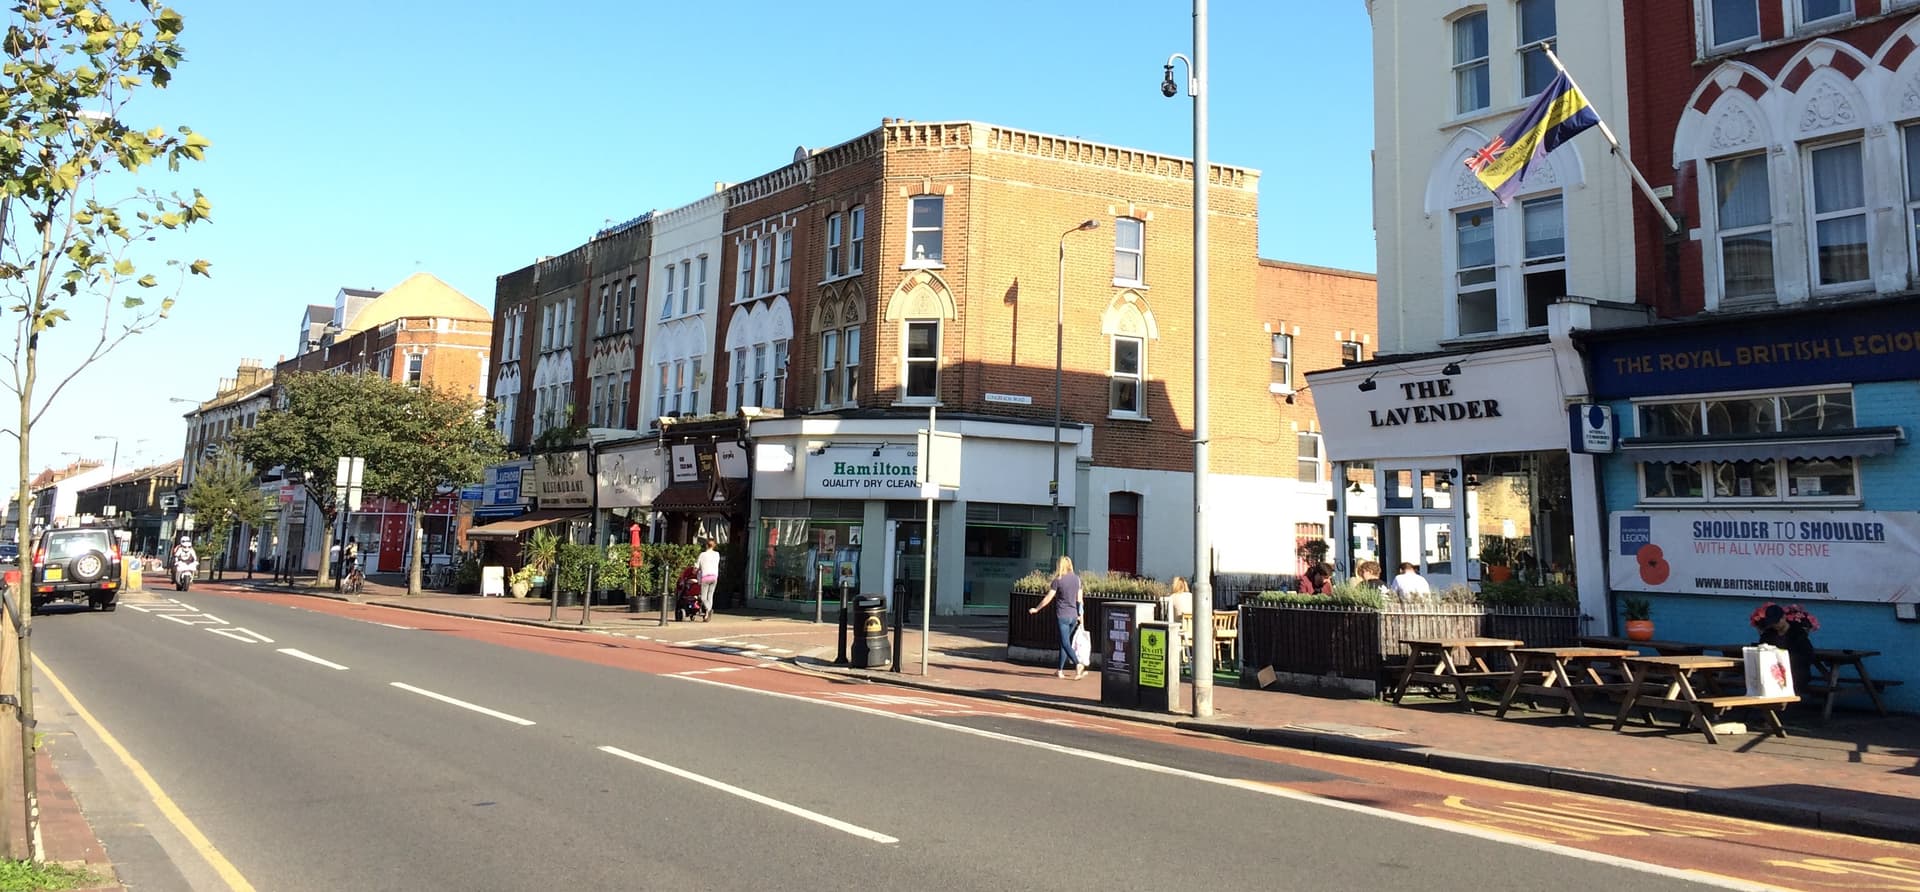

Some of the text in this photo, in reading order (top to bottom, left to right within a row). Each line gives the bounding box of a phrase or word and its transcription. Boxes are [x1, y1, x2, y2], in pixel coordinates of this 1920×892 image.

[1504, 144, 1525, 163] ROYAL
[1613, 356, 1653, 375] THE
[1660, 349, 1732, 371] ROYAL
[1736, 339, 1831, 366] BRITISH
[1400, 379, 1453, 400] THE
[1368, 399, 1502, 427] LAVENDER
[833, 461, 918, 476] Hamiltons
[822, 479, 918, 489] QUALITY DRY CLEAN
[1621, 533, 1649, 543] LEGION
[1693, 521, 1885, 541] SHOULDER TO SHOULDER
[1694, 541, 1831, 557] WITH ALL WHO SERVE
[1695, 577, 1829, 593] WWW.BRITISHLEGION.ORG.UK
